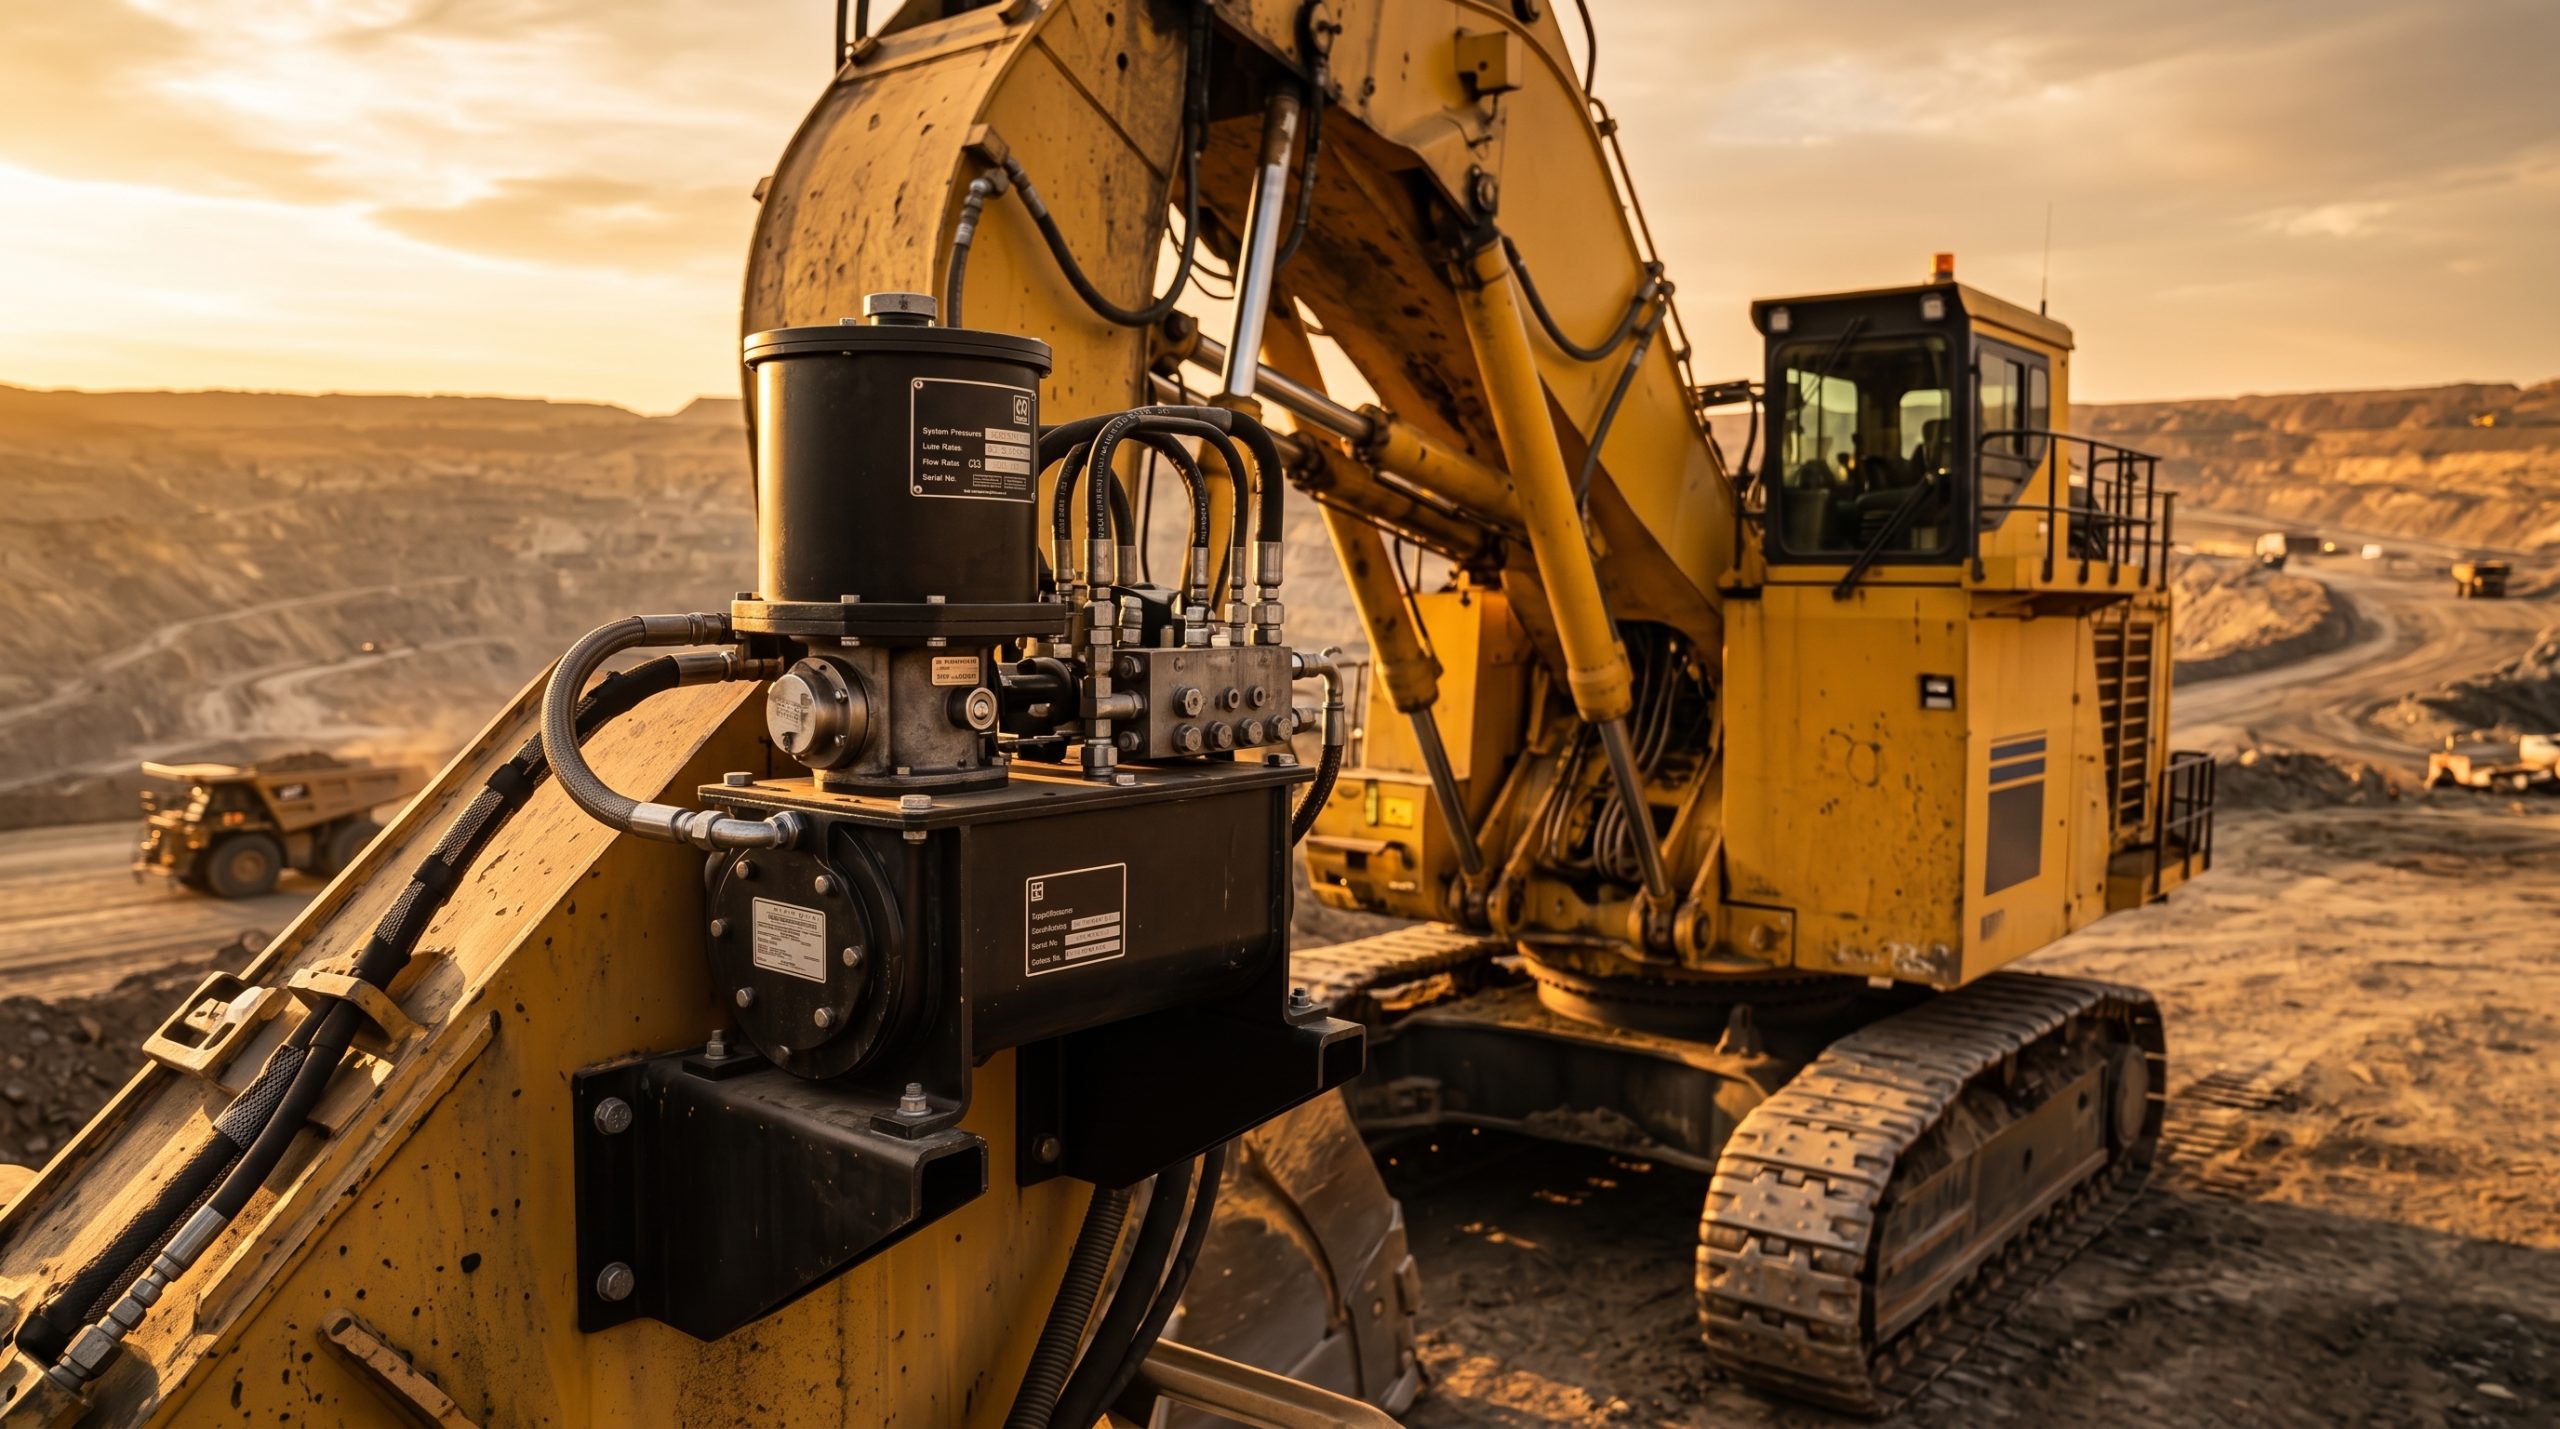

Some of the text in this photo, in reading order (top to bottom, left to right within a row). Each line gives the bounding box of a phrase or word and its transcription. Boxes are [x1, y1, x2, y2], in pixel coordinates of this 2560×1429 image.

[951, 428, 982, 438] Pressures
[922, 458, 939, 466] Flow
[922, 473, 943, 481] Serial
